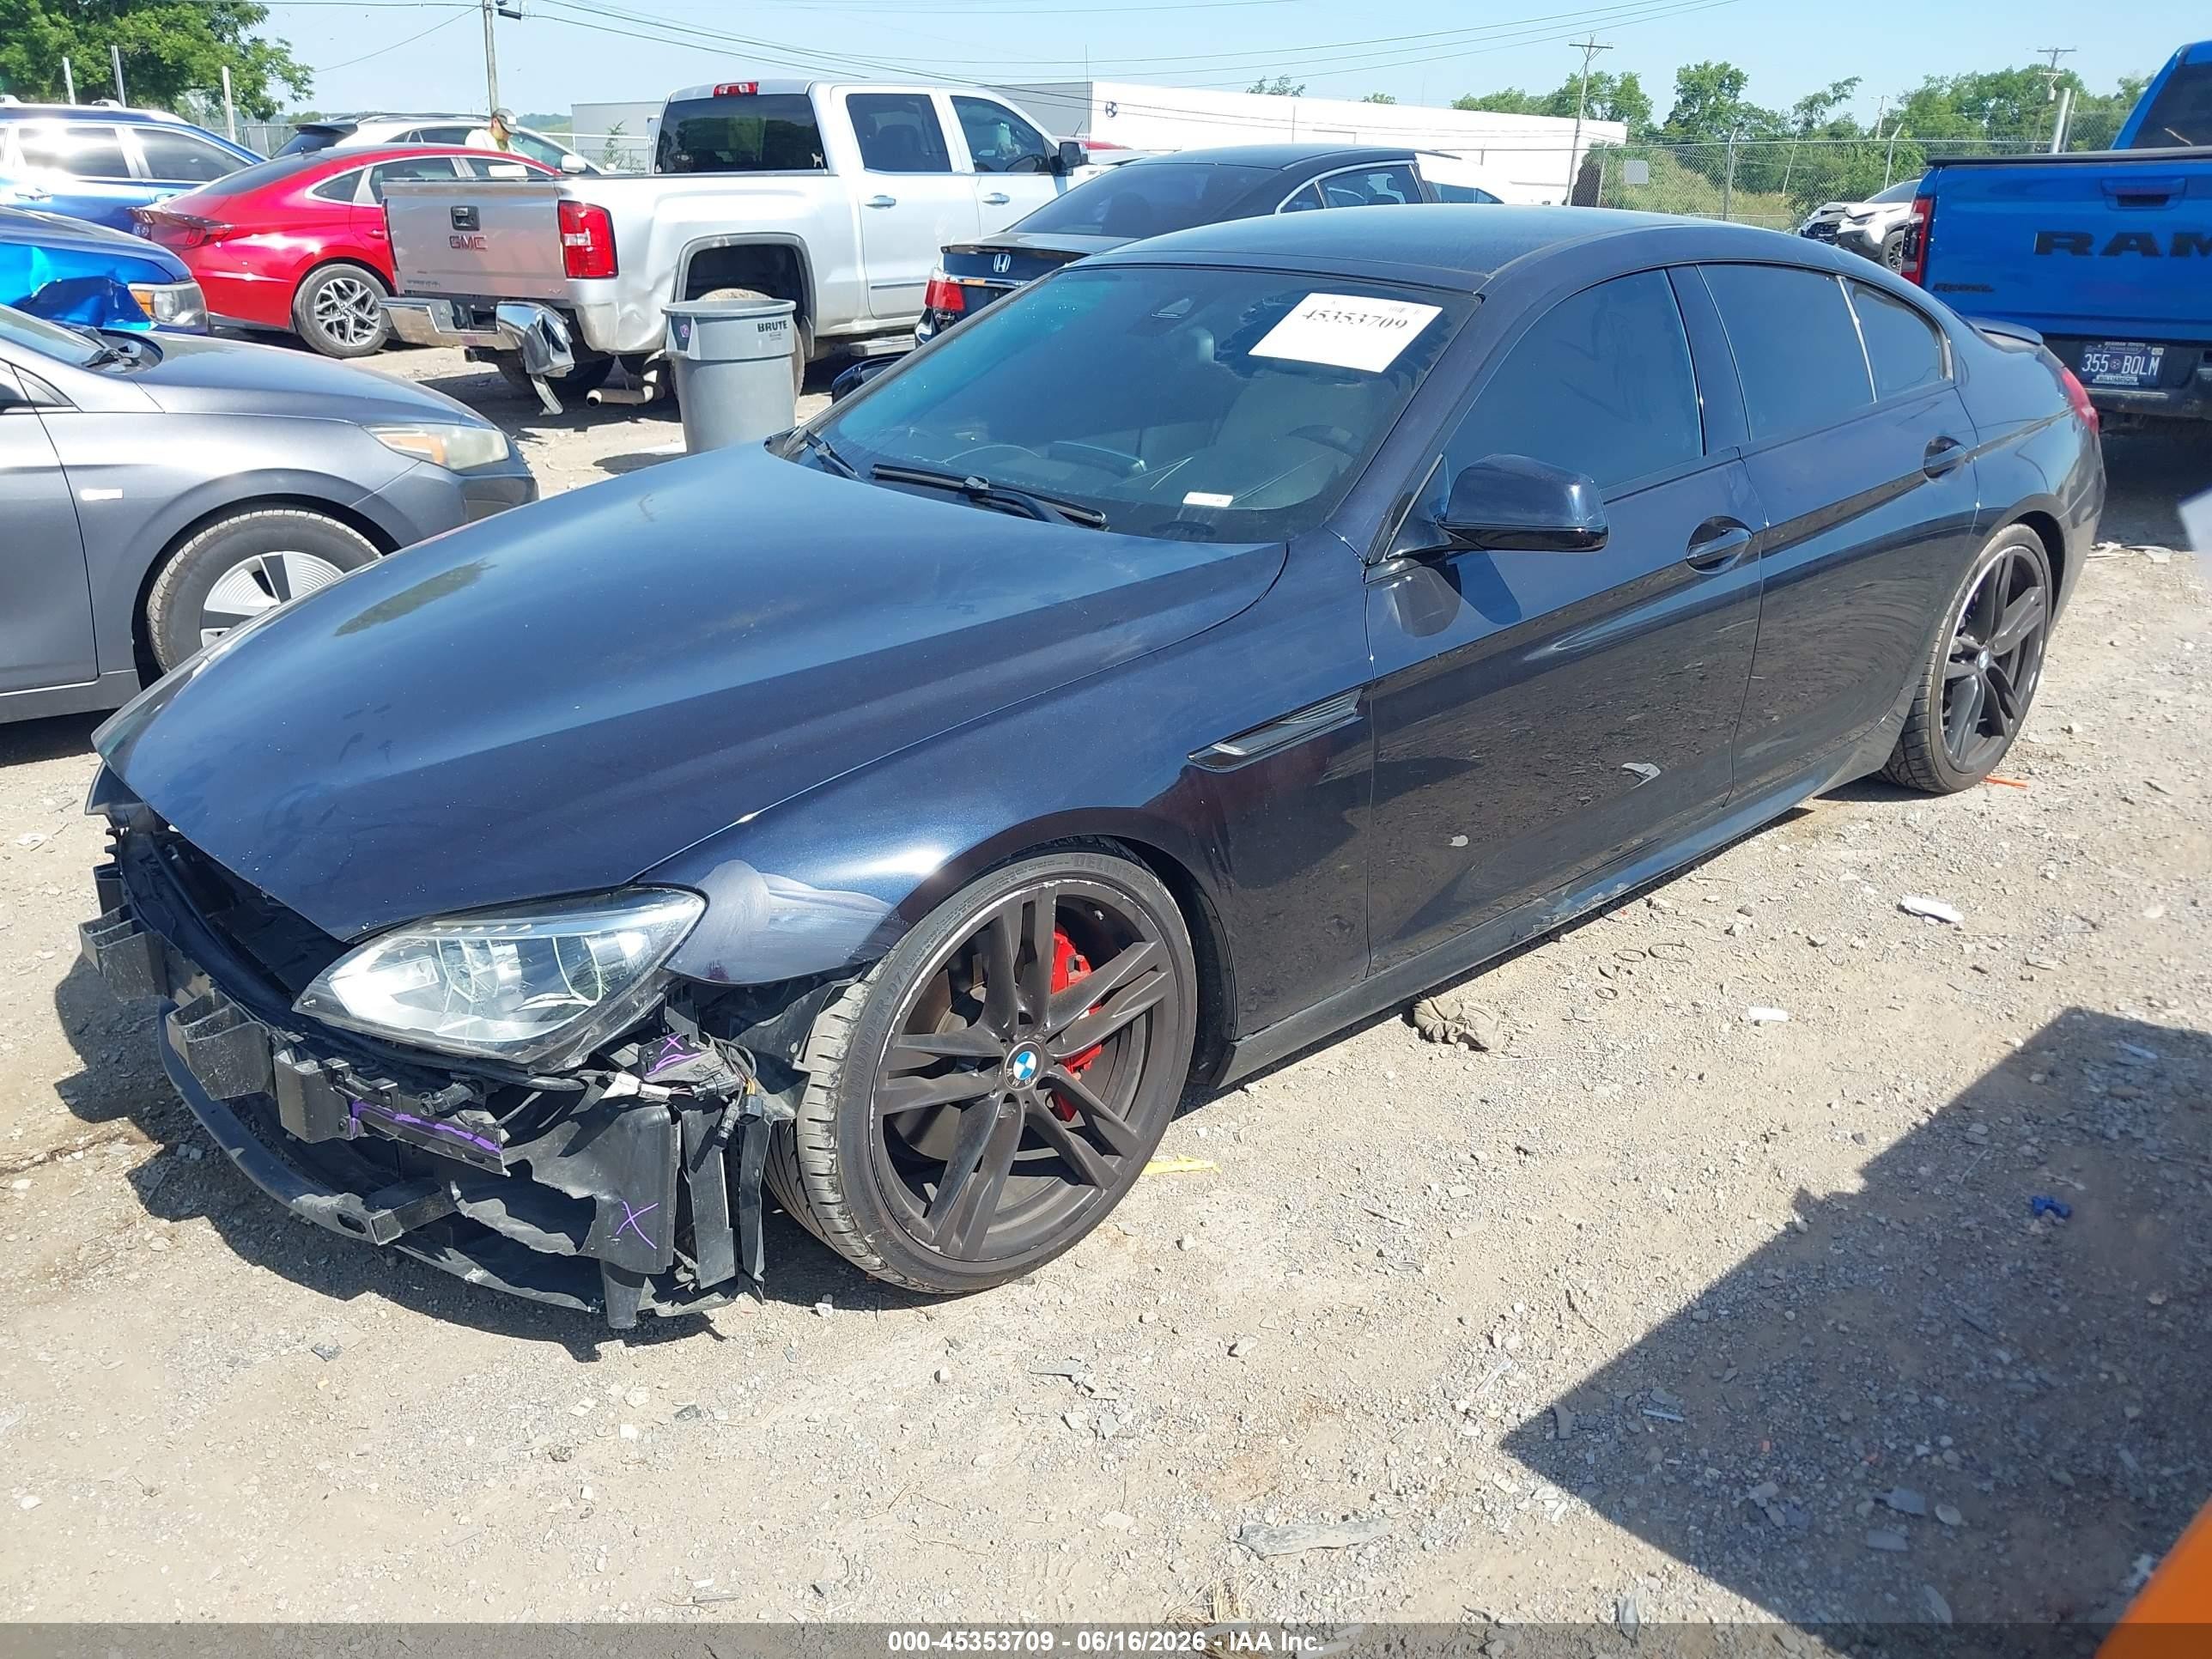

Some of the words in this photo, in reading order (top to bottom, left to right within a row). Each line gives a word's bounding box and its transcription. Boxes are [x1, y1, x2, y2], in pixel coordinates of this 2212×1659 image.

[450, 234, 488, 250] GMC
[757, 319, 787, 333] BRUTE
[1302, 309, 1408, 329] 45353709
[2081, 353, 2111, 373] 355
[2121, 355, 2160, 376] BQLM
